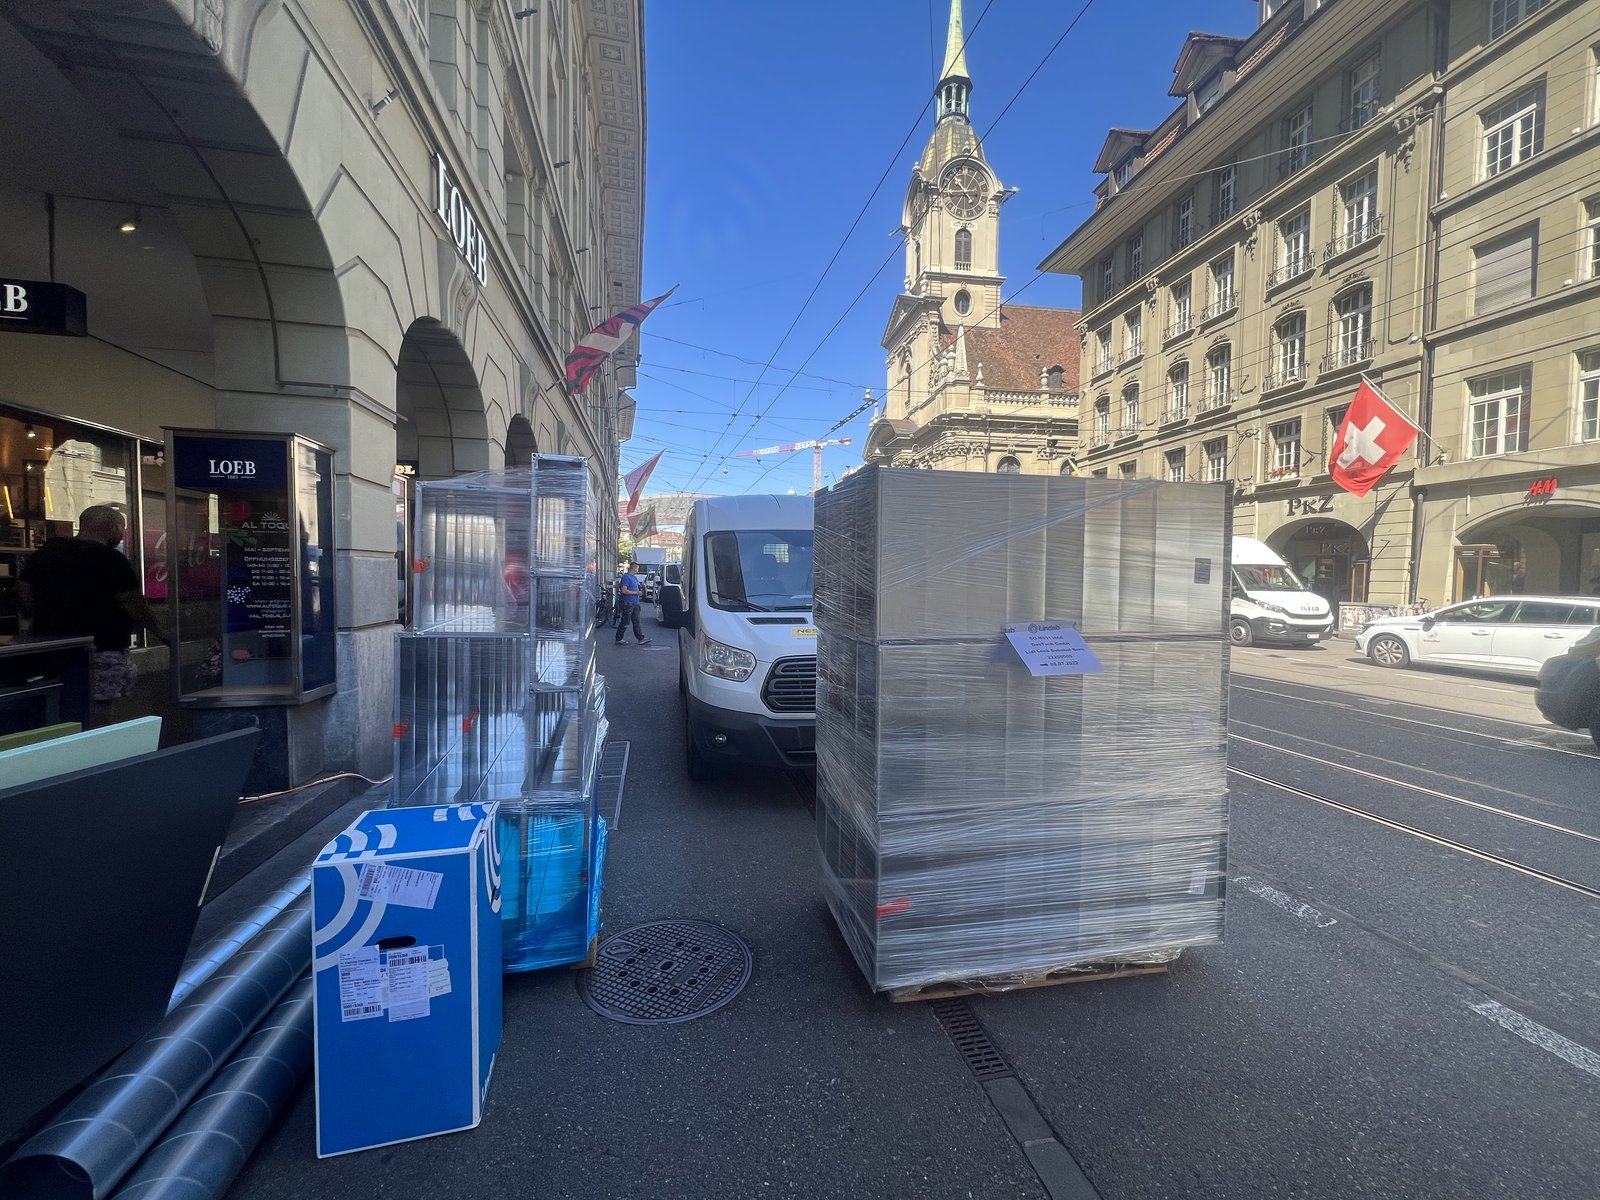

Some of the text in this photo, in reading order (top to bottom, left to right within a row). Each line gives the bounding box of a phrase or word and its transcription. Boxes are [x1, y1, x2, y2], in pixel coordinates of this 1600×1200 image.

[437, 152, 487, 287] LOEB
[0, 284, 28, 313] B
[209, 459, 256, 475] LOEB
[1528, 478, 1558, 496] H&M
[1286, 494, 1335, 517] PKZ
[241, 521, 258, 529] AL
[1039, 624, 1060, 632] Lindab
